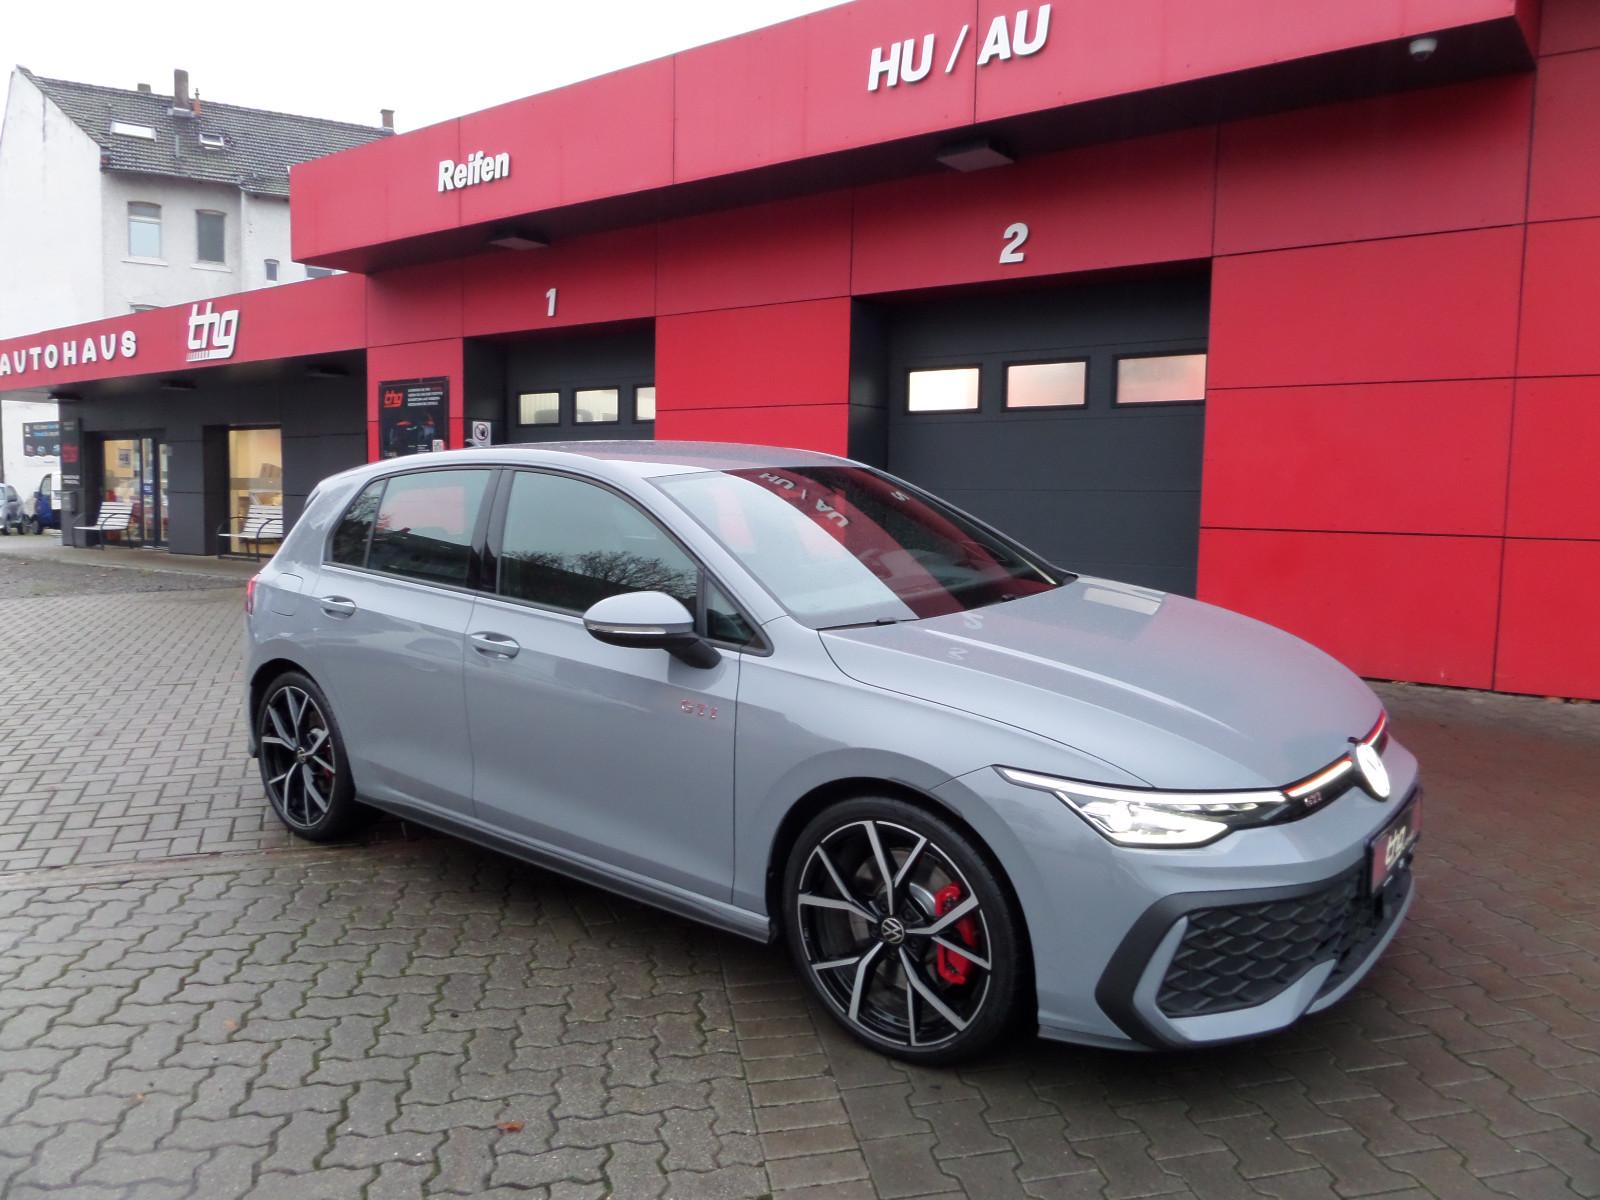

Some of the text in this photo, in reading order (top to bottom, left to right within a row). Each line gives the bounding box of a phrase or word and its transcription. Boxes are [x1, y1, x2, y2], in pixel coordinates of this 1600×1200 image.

[868, 3, 1051, 91] HU / AU
[437, 150, 510, 192] Reifen
[999, 222, 1029, 264] 2
[545, 287, 557, 317] 1
[0, 301, 239, 376] AUTOHAUS thg
